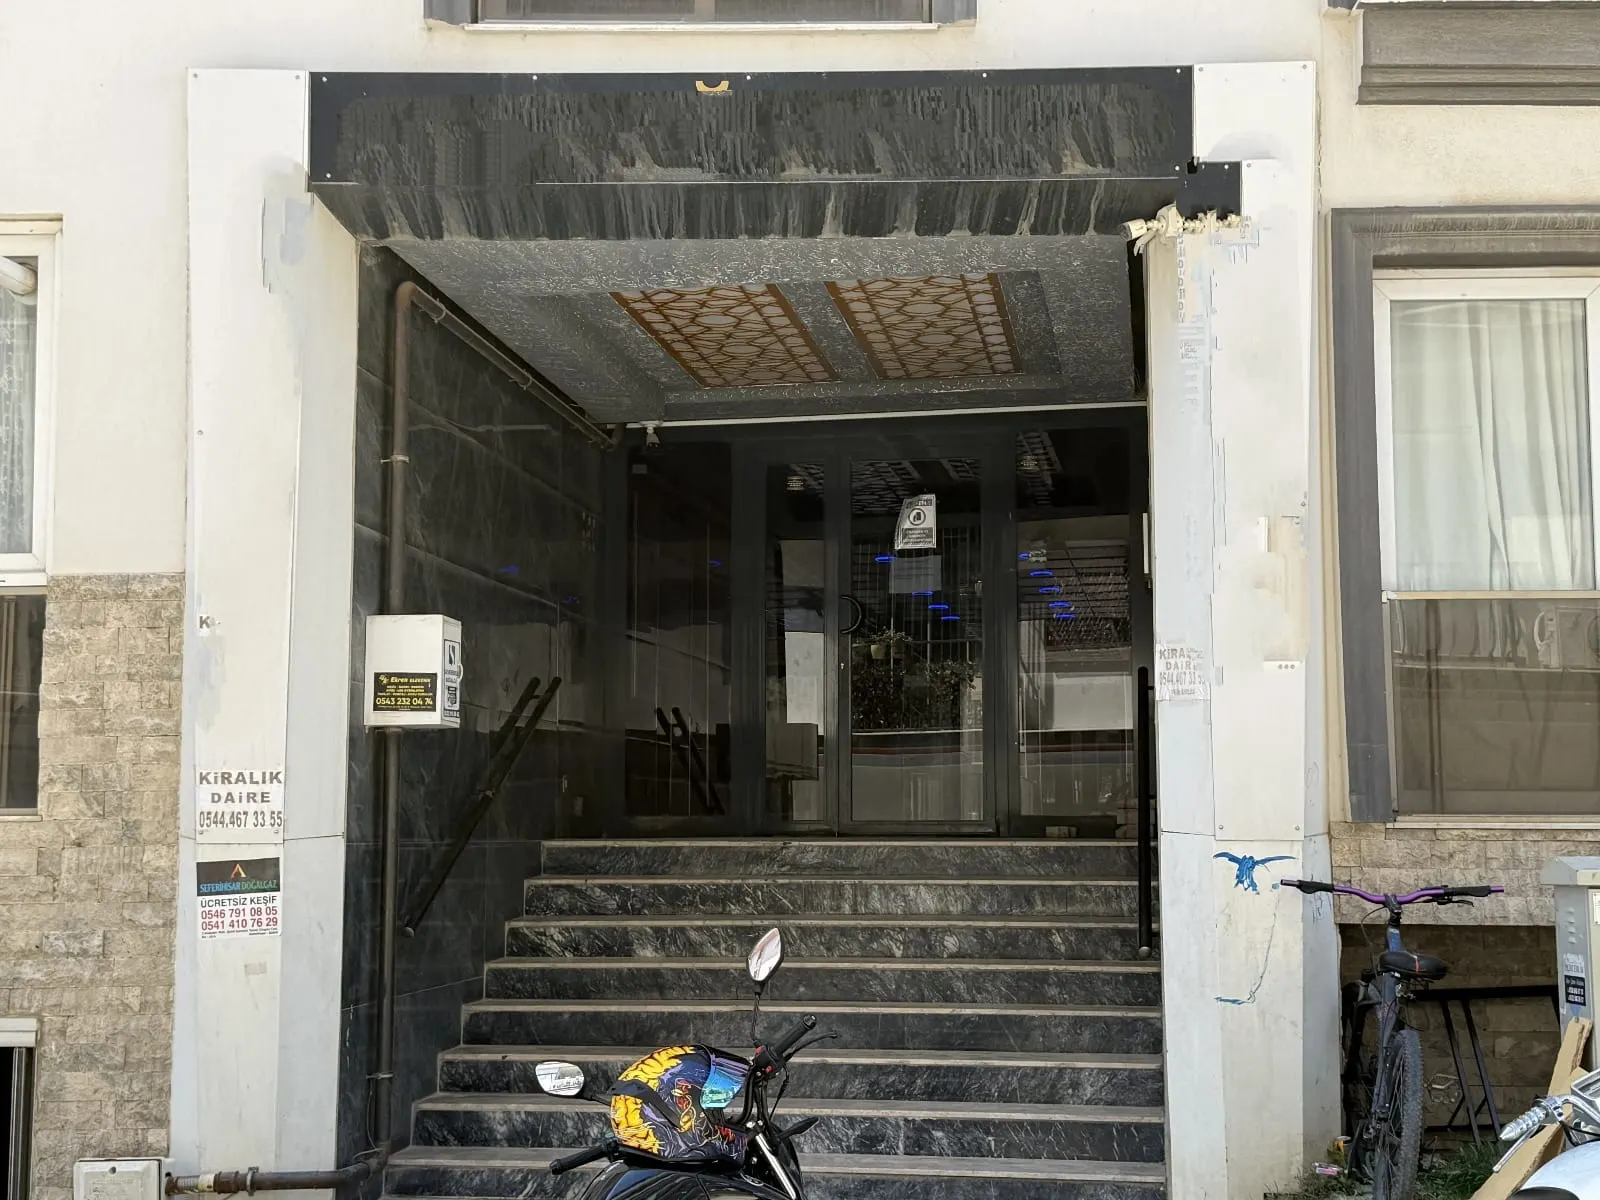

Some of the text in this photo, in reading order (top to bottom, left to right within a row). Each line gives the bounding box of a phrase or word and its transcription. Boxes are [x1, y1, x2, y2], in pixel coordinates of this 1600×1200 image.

[396, 697, 411, 705] 232
[412, 697, 423, 705] 04
[199, 810, 283, 828] 0544.467 33 55
[200, 894, 278, 908] ÜCRETSİZ KEŞİF
[201, 905, 278, 920] 0546 791 08 05
[201, 916, 278, 931] 0541 410 76 29
